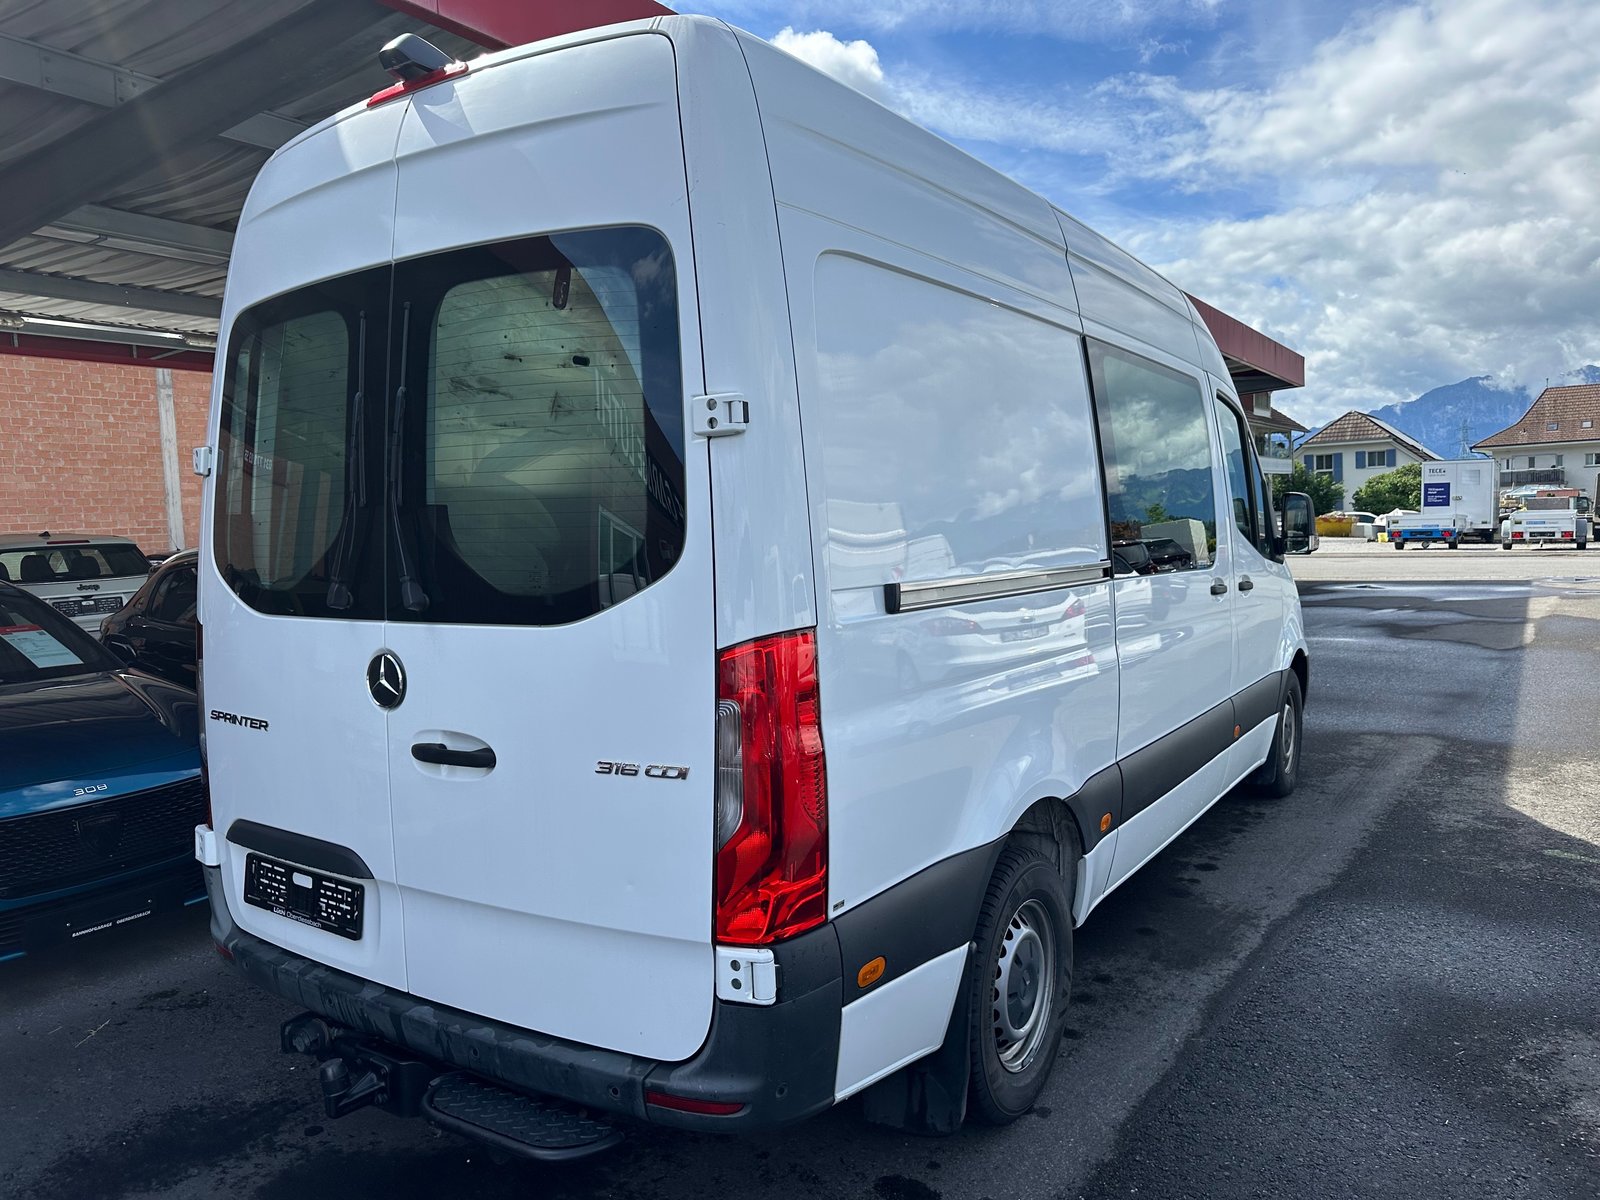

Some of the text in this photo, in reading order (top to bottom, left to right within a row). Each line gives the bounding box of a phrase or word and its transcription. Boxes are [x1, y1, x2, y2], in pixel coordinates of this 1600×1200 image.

[77, 583, 100, 591] Jeep
[210, 709, 269, 732] SPRINTER
[595, 760, 690, 781] 316 CDI
[73, 783, 108, 796] 308
